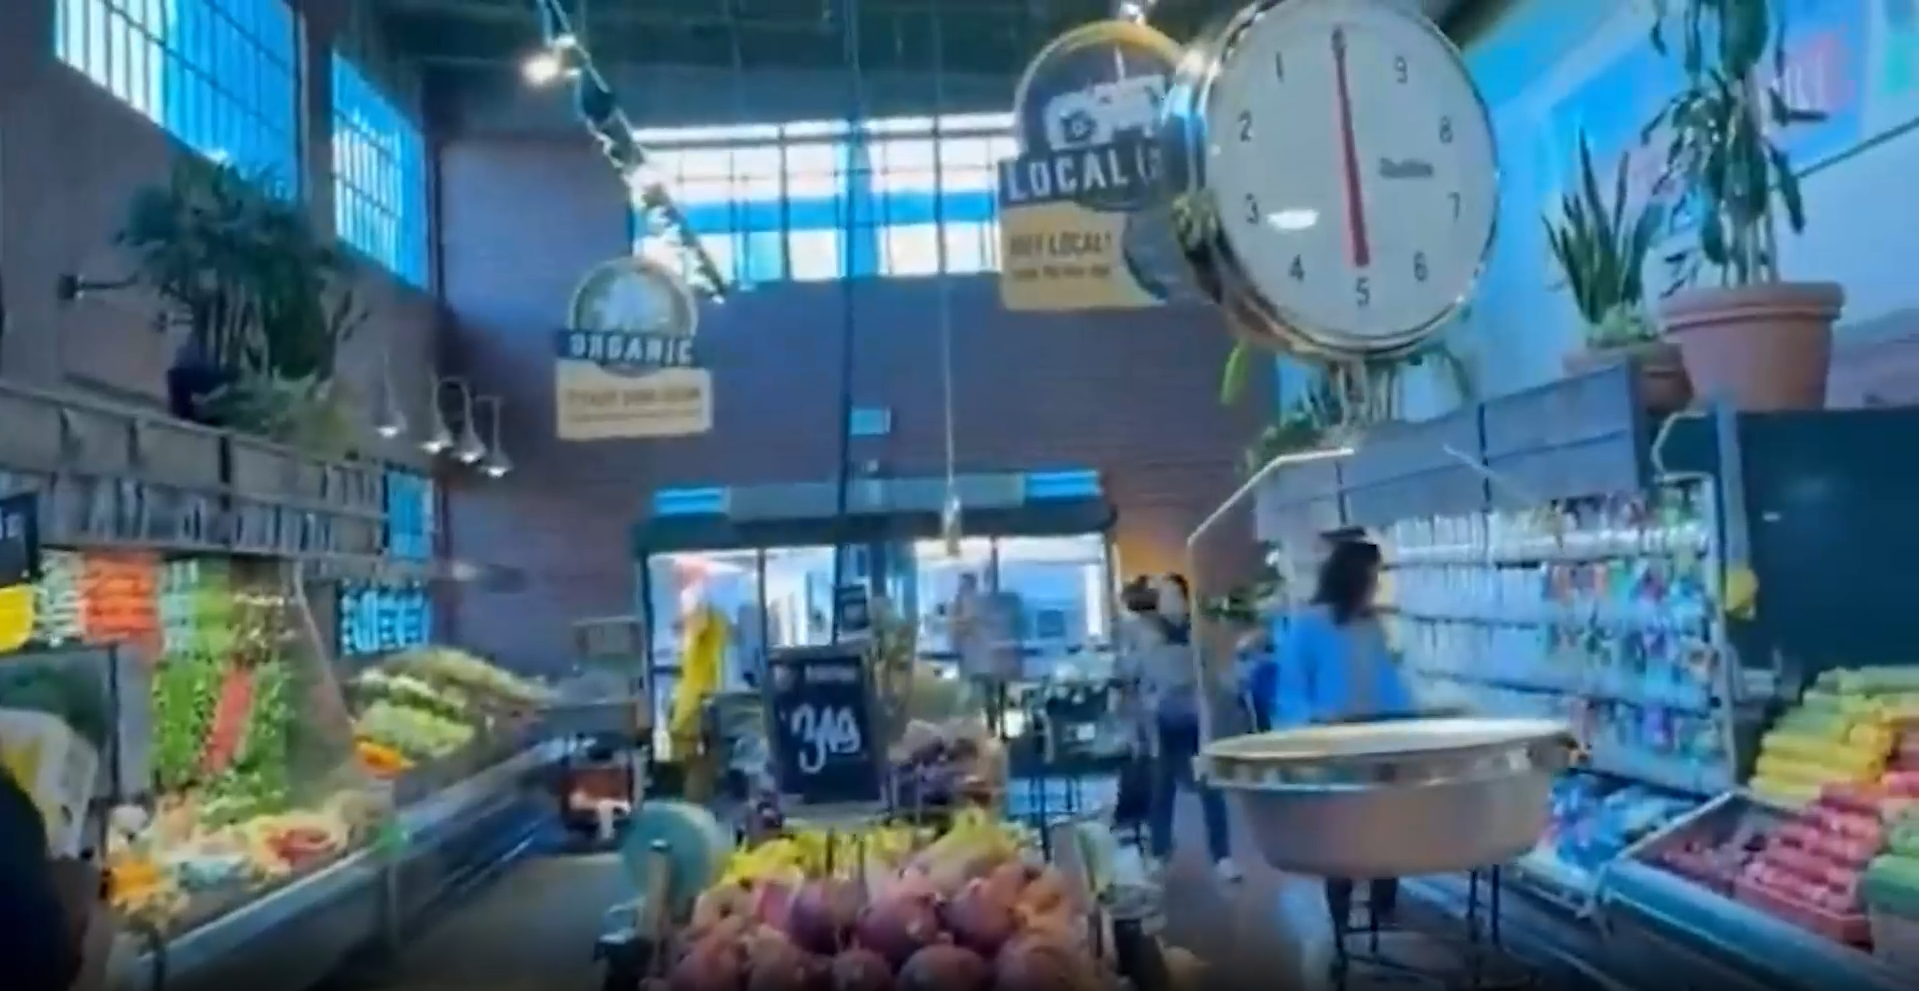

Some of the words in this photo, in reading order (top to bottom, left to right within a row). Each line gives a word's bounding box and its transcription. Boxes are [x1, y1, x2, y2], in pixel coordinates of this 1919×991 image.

[1275, 51, 1284, 83] 1
[1395, 54, 1408, 84] 9
[1238, 110, 1253, 142] 2
[1439, 115, 1453, 143] 8
[1006, 147, 1131, 201] LOCAL
[1246, 192, 1260, 225] 3
[1448, 191, 1461, 221] 7
[1289, 254, 1305, 283] 4
[1413, 251, 1428, 282] 6
[1355, 277, 1371, 307] 5
[569, 331, 694, 365] ORGANIC
